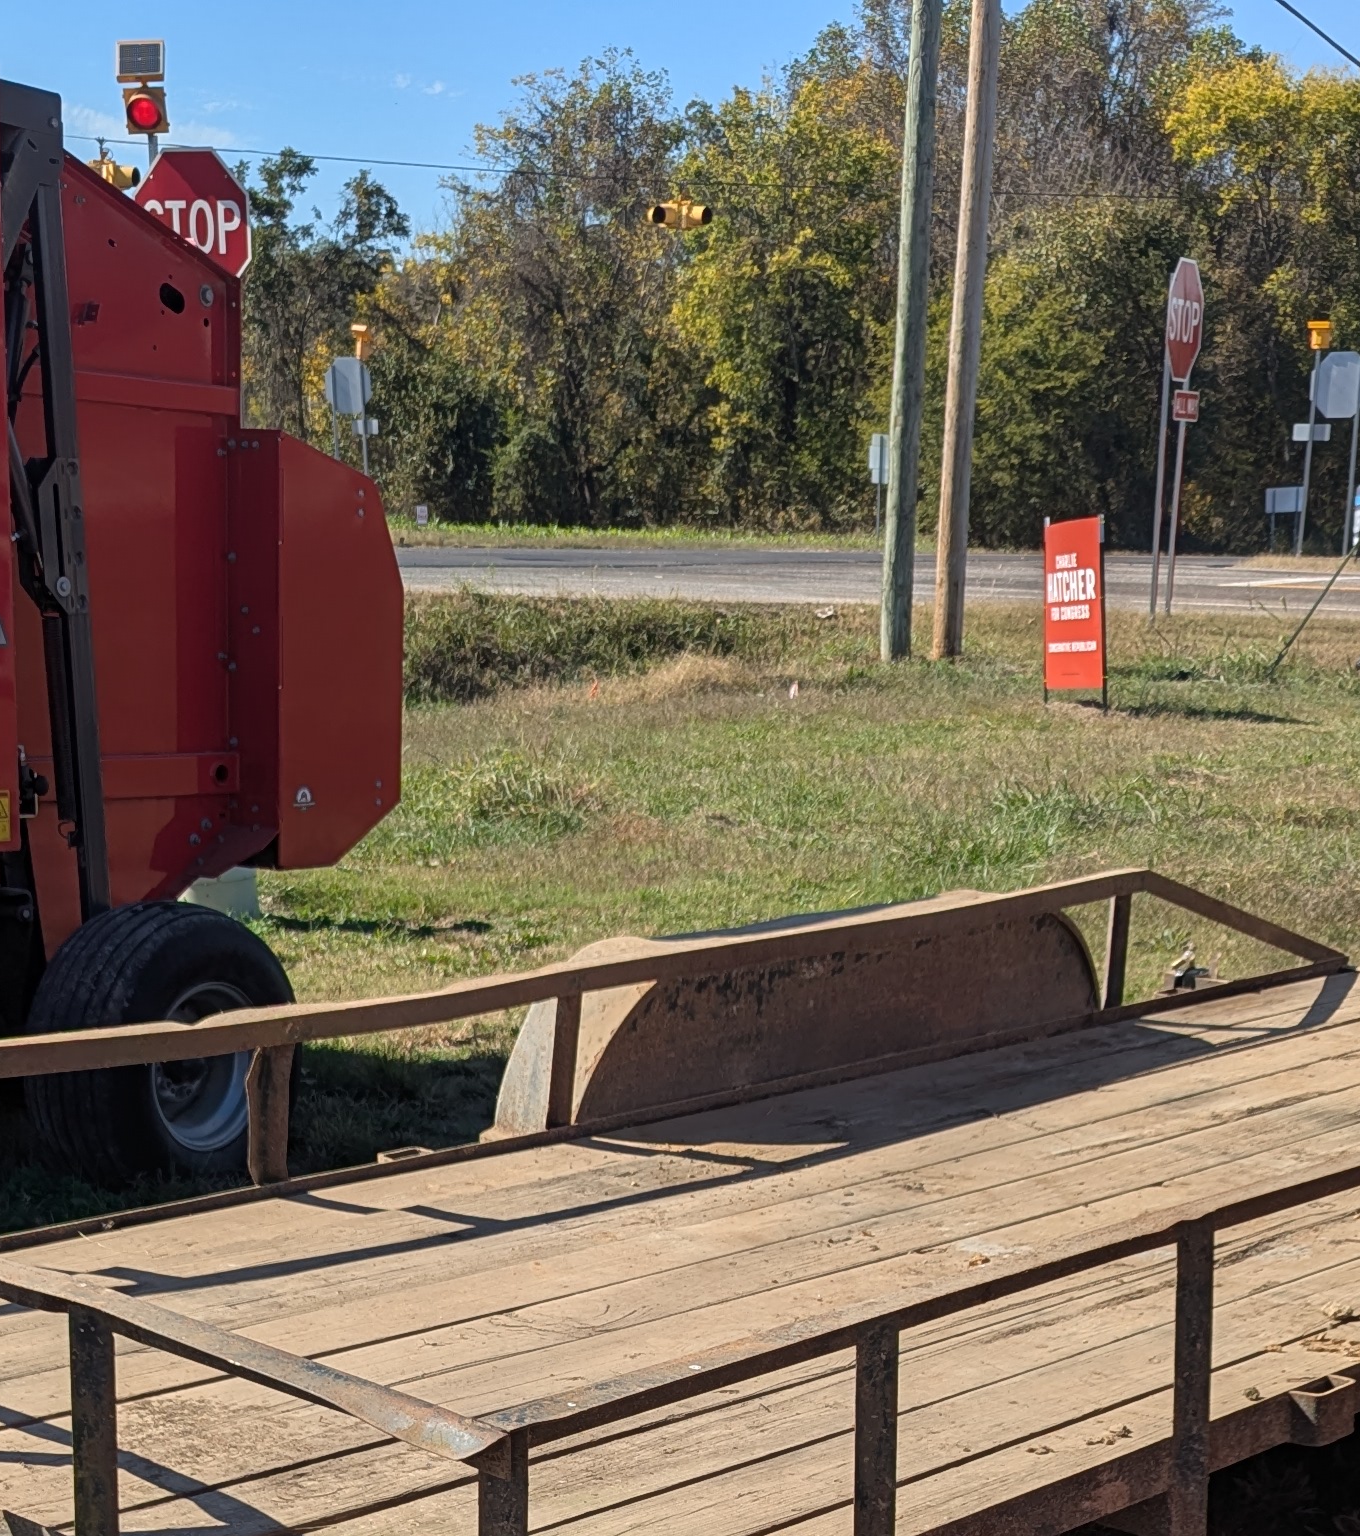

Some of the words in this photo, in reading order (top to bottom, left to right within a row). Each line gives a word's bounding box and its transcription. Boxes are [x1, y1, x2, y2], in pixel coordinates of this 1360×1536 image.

[143, 199, 241, 255] TOP
[1168, 296, 1200, 344] STOP
[1047, 568, 1097, 604] HATCHER
